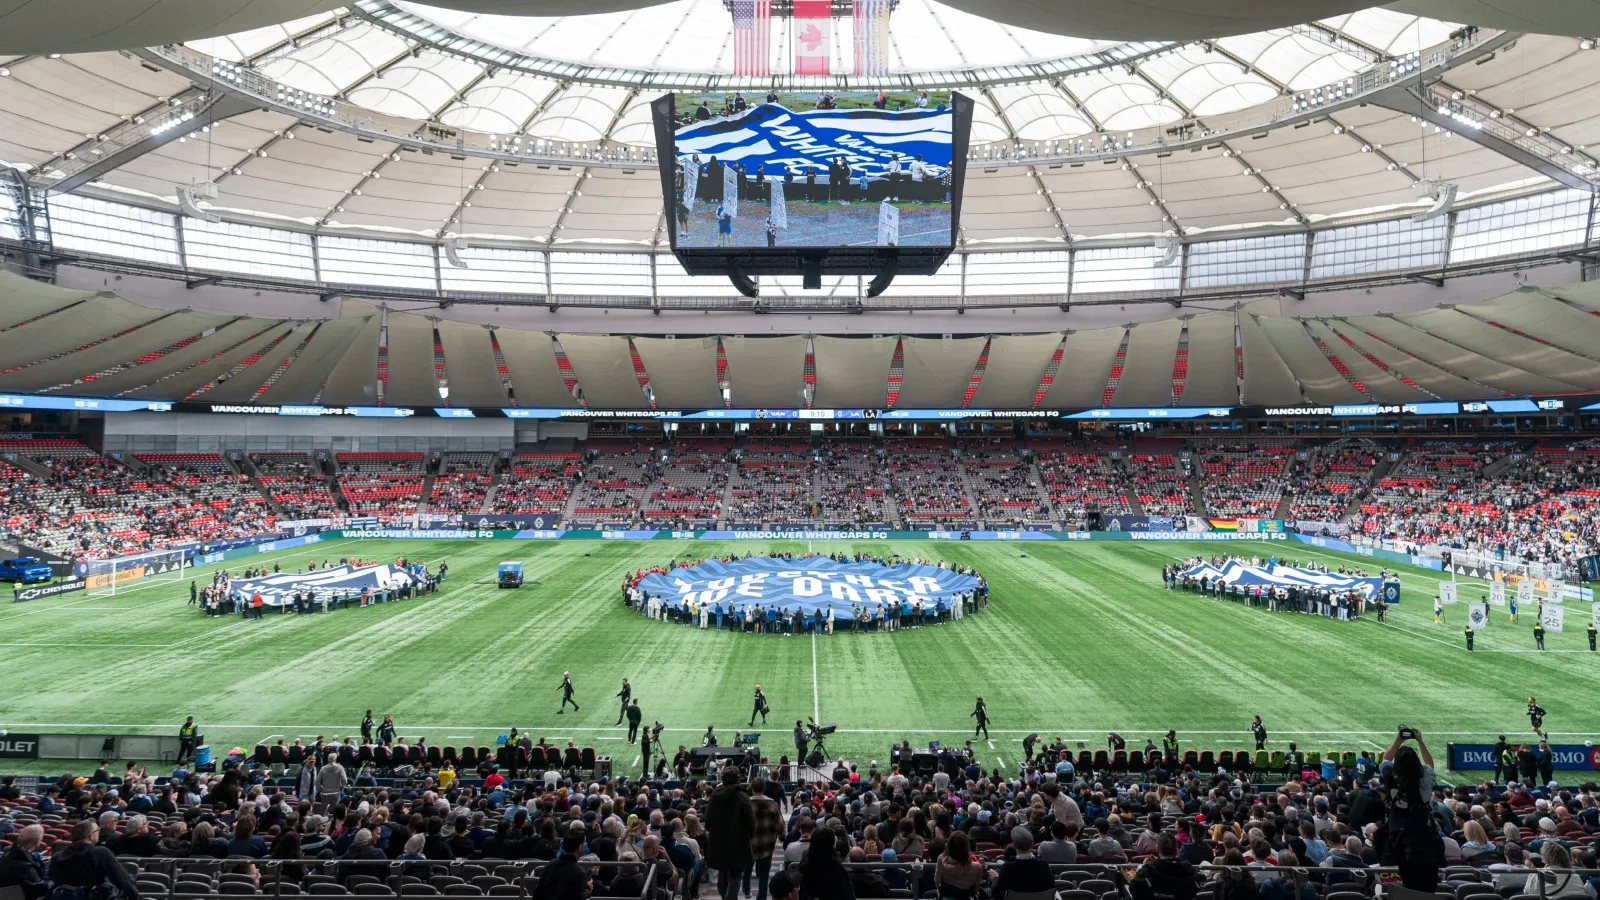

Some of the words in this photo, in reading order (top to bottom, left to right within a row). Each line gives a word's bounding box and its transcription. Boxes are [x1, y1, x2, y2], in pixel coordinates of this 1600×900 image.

[211, 405, 279, 414] VANCOUVER
[282, 406, 342, 415] WHITECAPS
[1334, 406, 1400, 414] WHITECAPS
[1131, 532, 1200, 540] VANCOUVER
[1203, 532, 1269, 540] WHITECAPS
[1271, 532, 1286, 540] FC
[42, 581, 86, 595] CHEVROLET
[1492, 593, 1503, 602] 20
[1519, 592, 1531, 600] 45
[1551, 592, 1558, 600] 3
[1544, 616, 1560, 628] 25
[1290, 753, 1296, 762] 3
[1551, 752, 1585, 763] BMO
